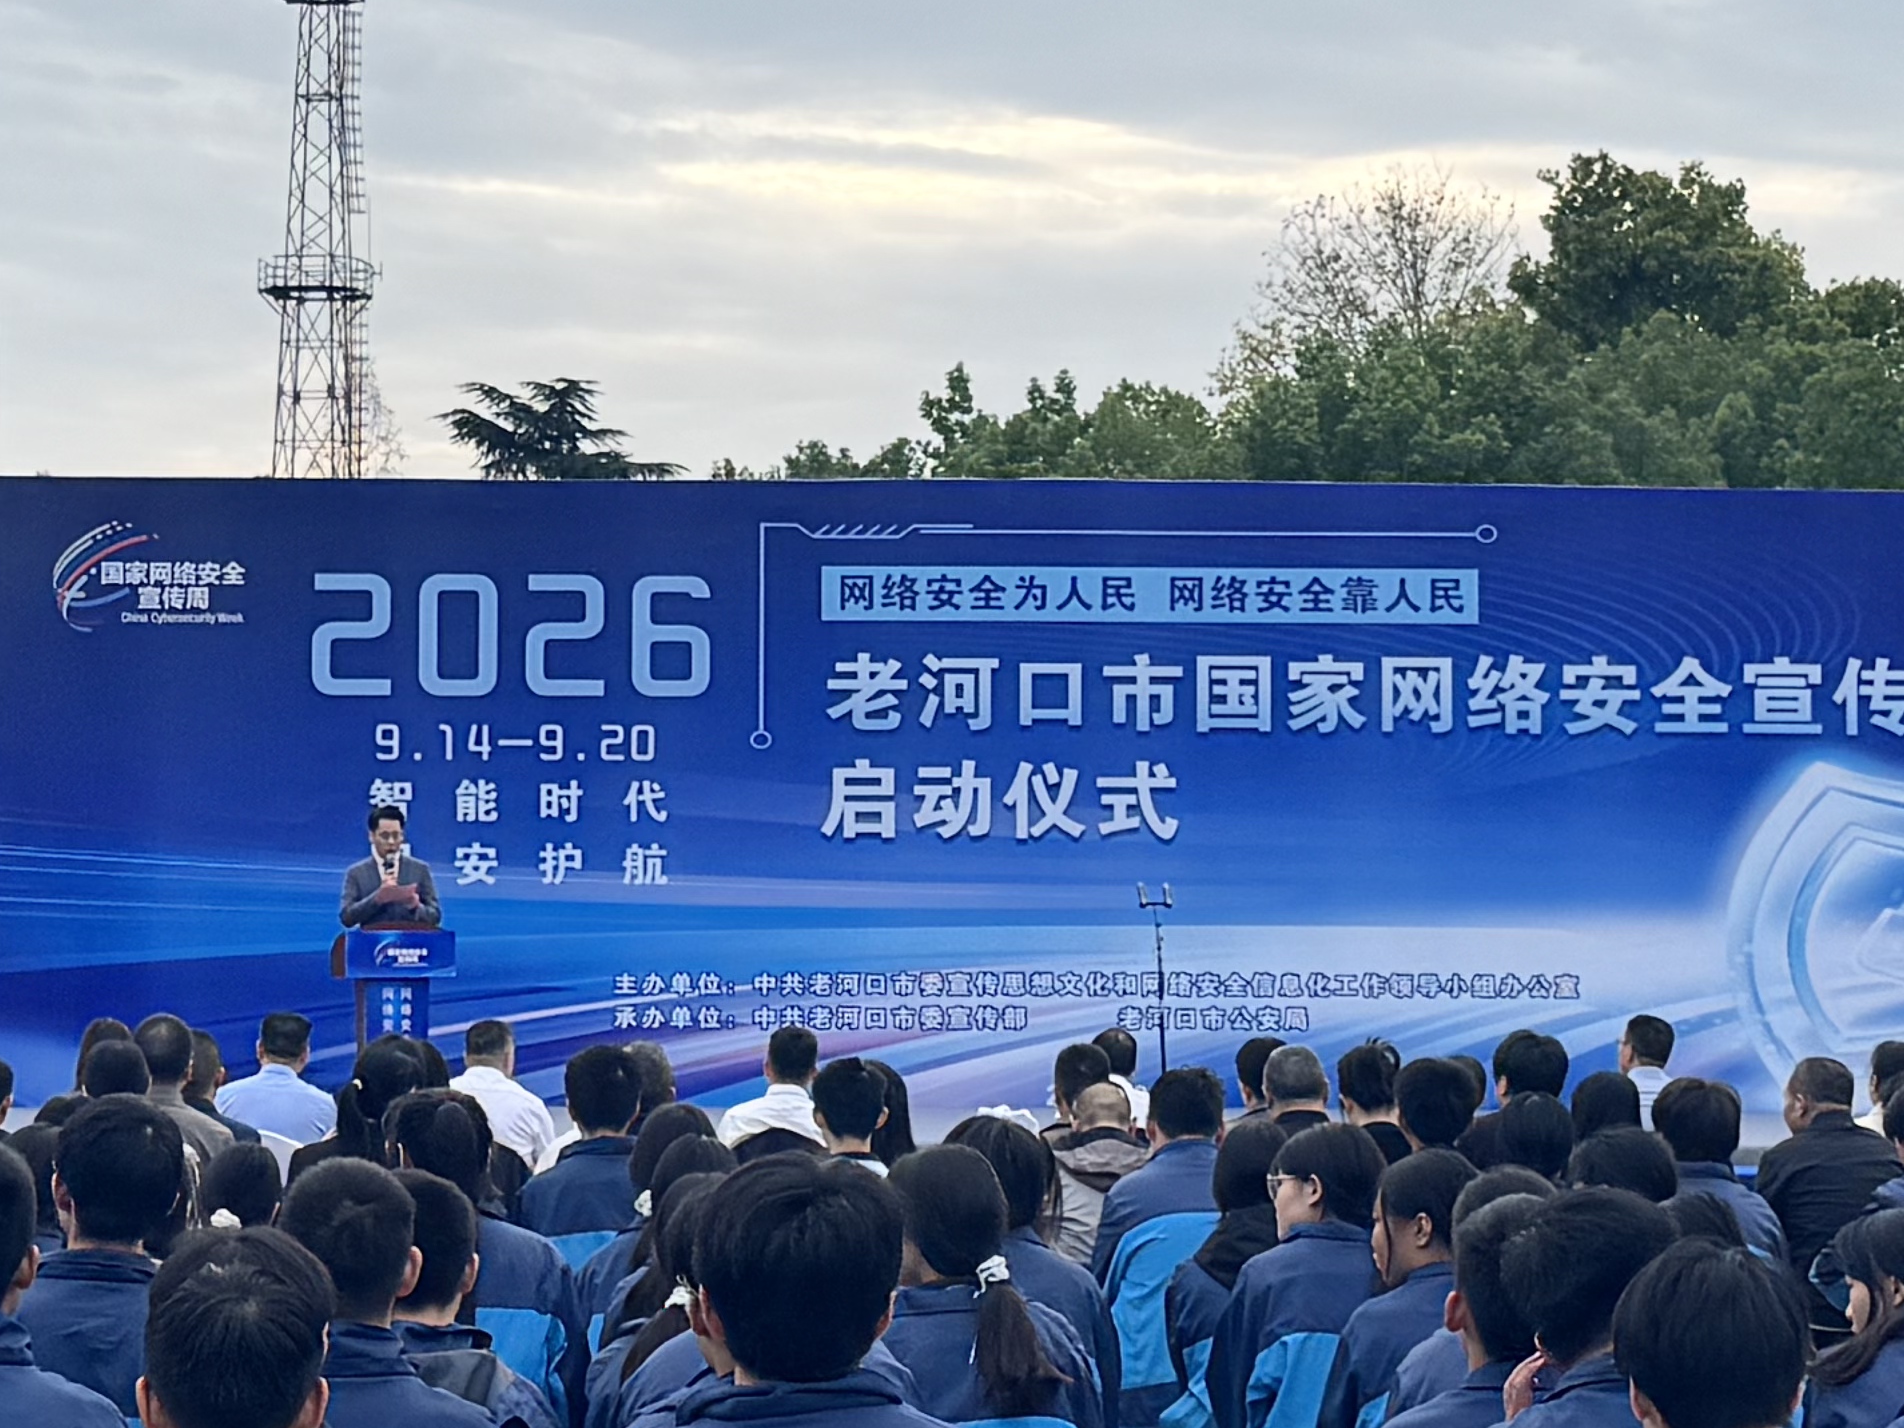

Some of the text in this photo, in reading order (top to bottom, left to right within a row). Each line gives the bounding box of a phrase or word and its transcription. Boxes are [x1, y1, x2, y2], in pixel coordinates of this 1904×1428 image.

[100, 561, 246, 586] 国家网络安全
[839, 573, 1466, 615] 网络安全为人民 网络安全靠人民
[137, 587, 210, 610] 宣传周
[311, 573, 712, 698] 2026
[820, 759, 1181, 841] 启动仪式
[370, 842, 669, 886] 安护航
